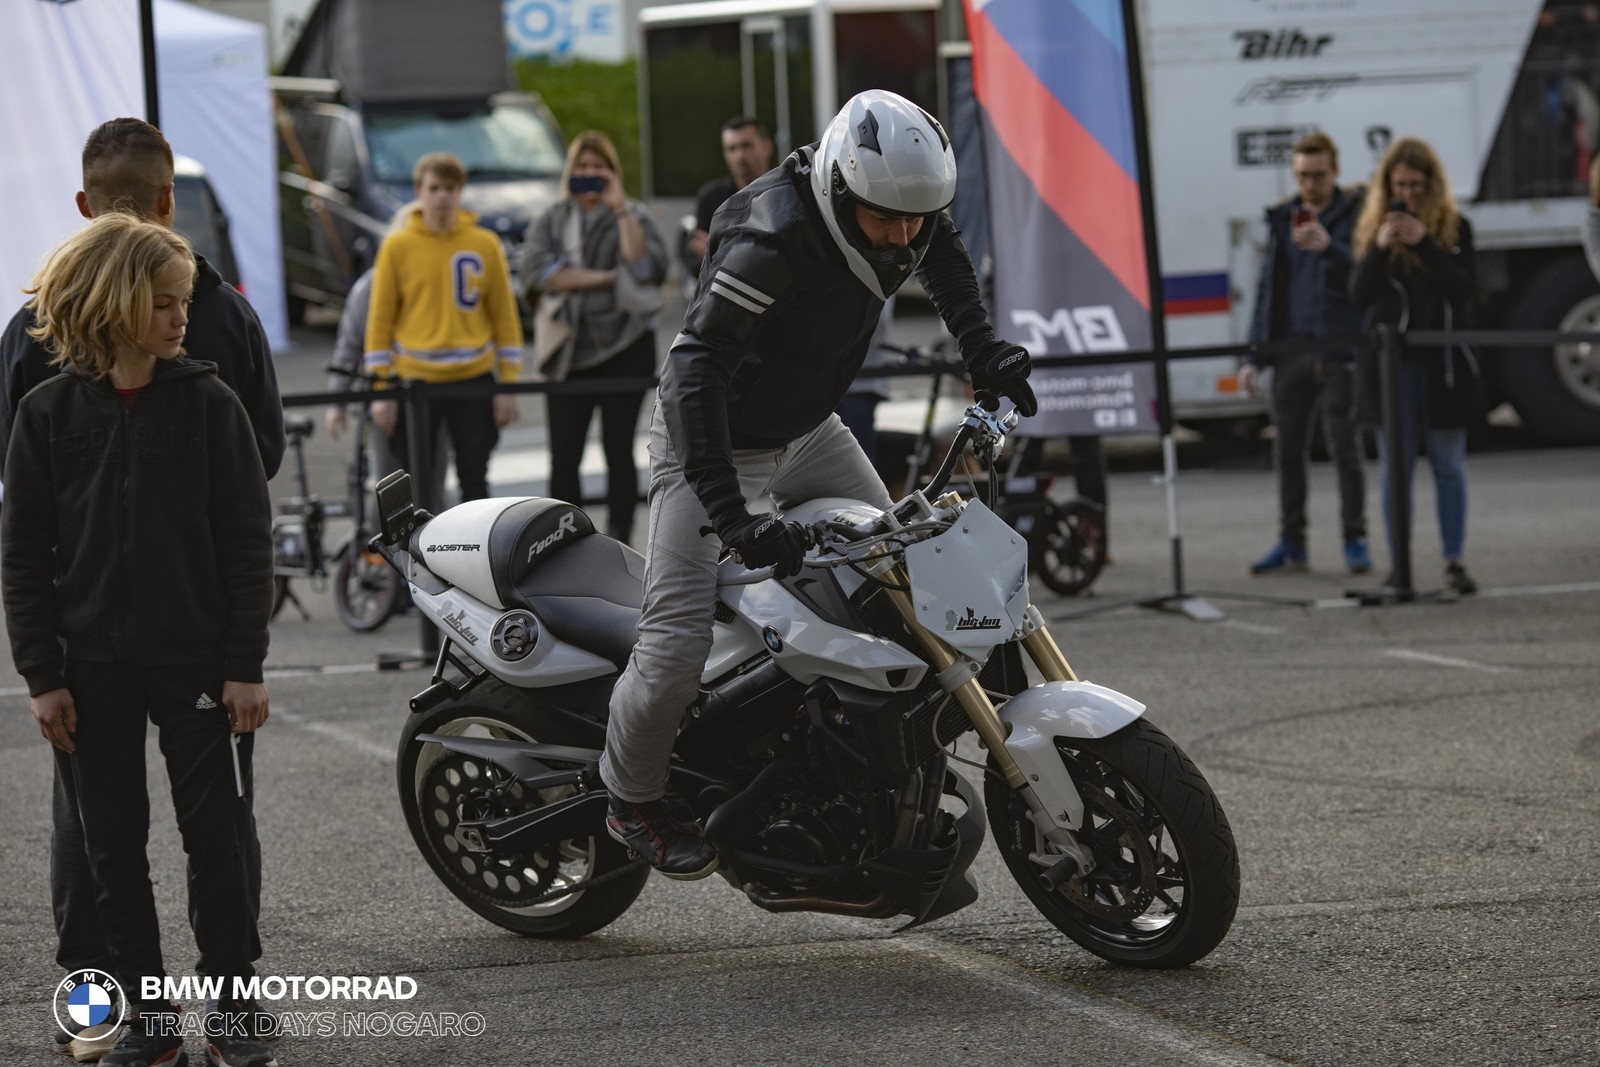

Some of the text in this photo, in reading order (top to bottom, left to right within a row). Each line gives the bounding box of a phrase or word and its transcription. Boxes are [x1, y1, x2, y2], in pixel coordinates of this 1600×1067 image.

[1233, 28, 1334, 60] Bihr
[451, 250, 485, 314] C
[998, 350, 1025, 370] RST
[426, 544, 480, 553] BAGSTER
